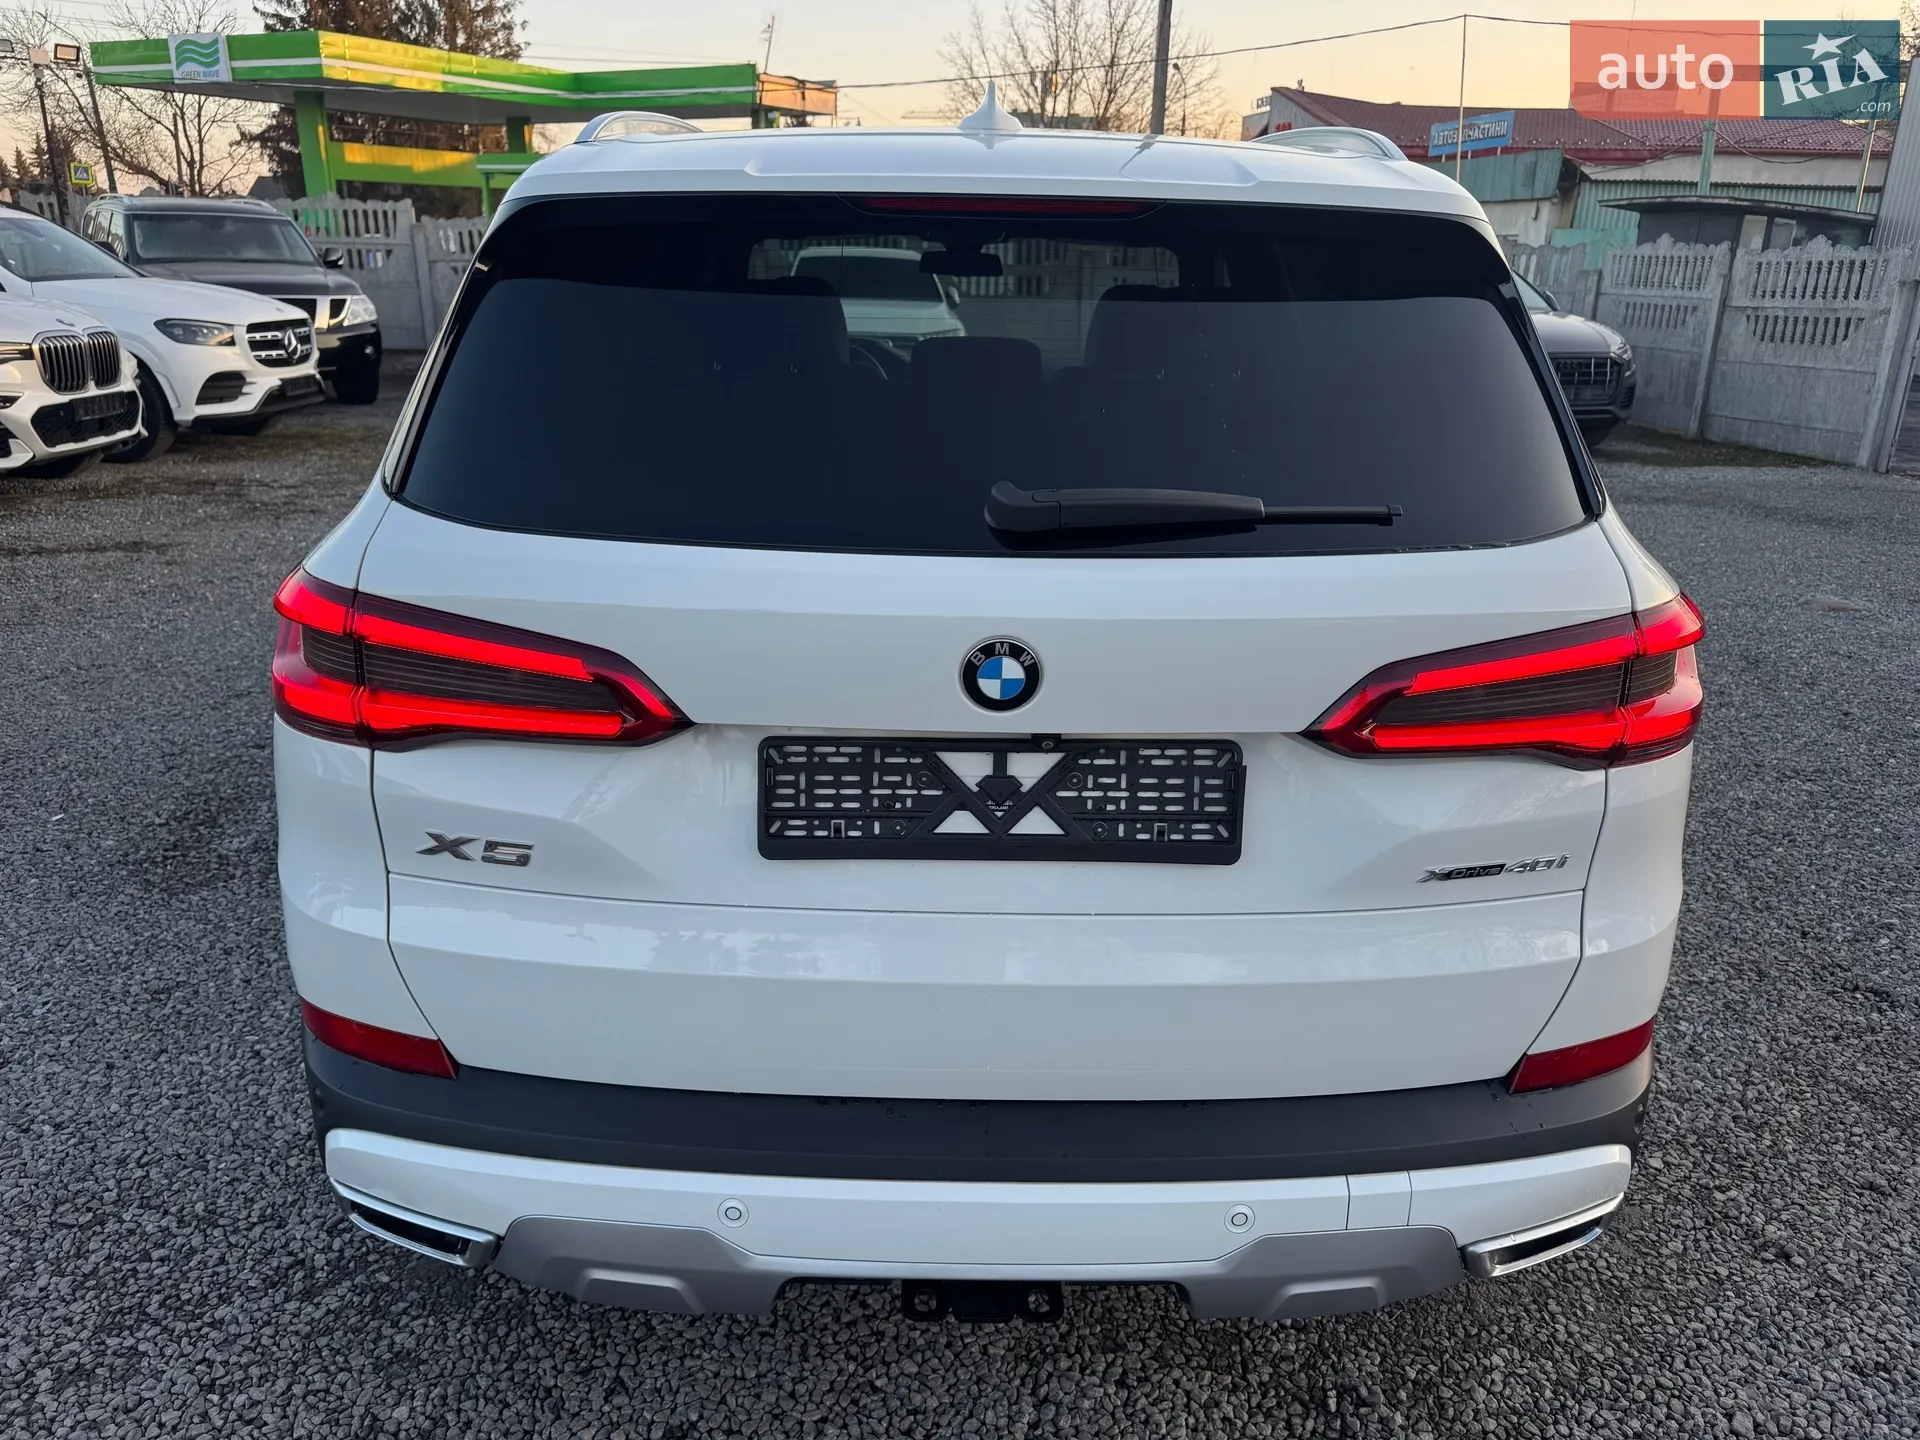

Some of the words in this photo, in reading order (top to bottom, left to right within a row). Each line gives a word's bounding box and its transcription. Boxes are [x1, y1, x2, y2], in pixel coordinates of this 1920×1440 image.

[181, 70, 201, 79] GREEN
[202, 69, 220, 78] WAVE
[1432, 120, 1508, 148] АВТОЗПЧАСТИНИ
[969, 642, 1035, 667] BMW
[415, 828, 535, 867] X5
